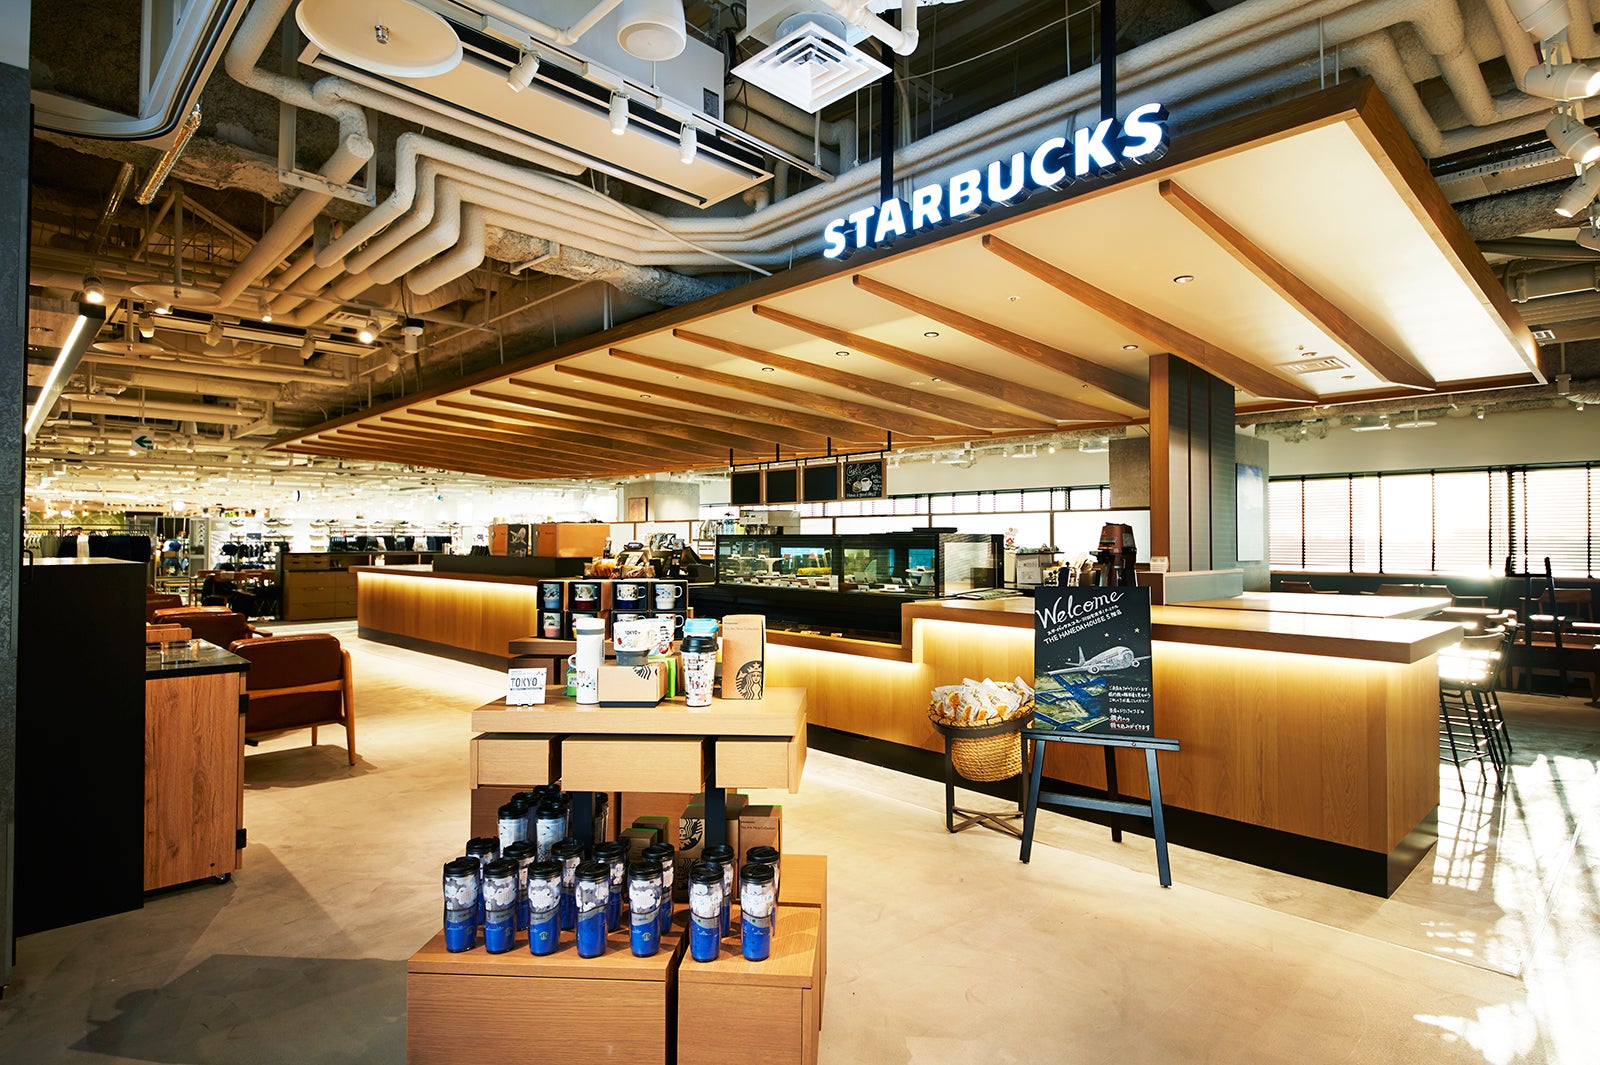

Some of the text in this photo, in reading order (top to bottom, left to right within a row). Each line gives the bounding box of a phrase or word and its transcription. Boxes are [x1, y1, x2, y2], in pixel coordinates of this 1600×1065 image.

[823, 102, 1167, 260] STARBUCKS
[1035, 591, 1125, 629] Welcome
[1043, 634, 1060, 645] THE
[510, 676, 538, 688] TOKYO
